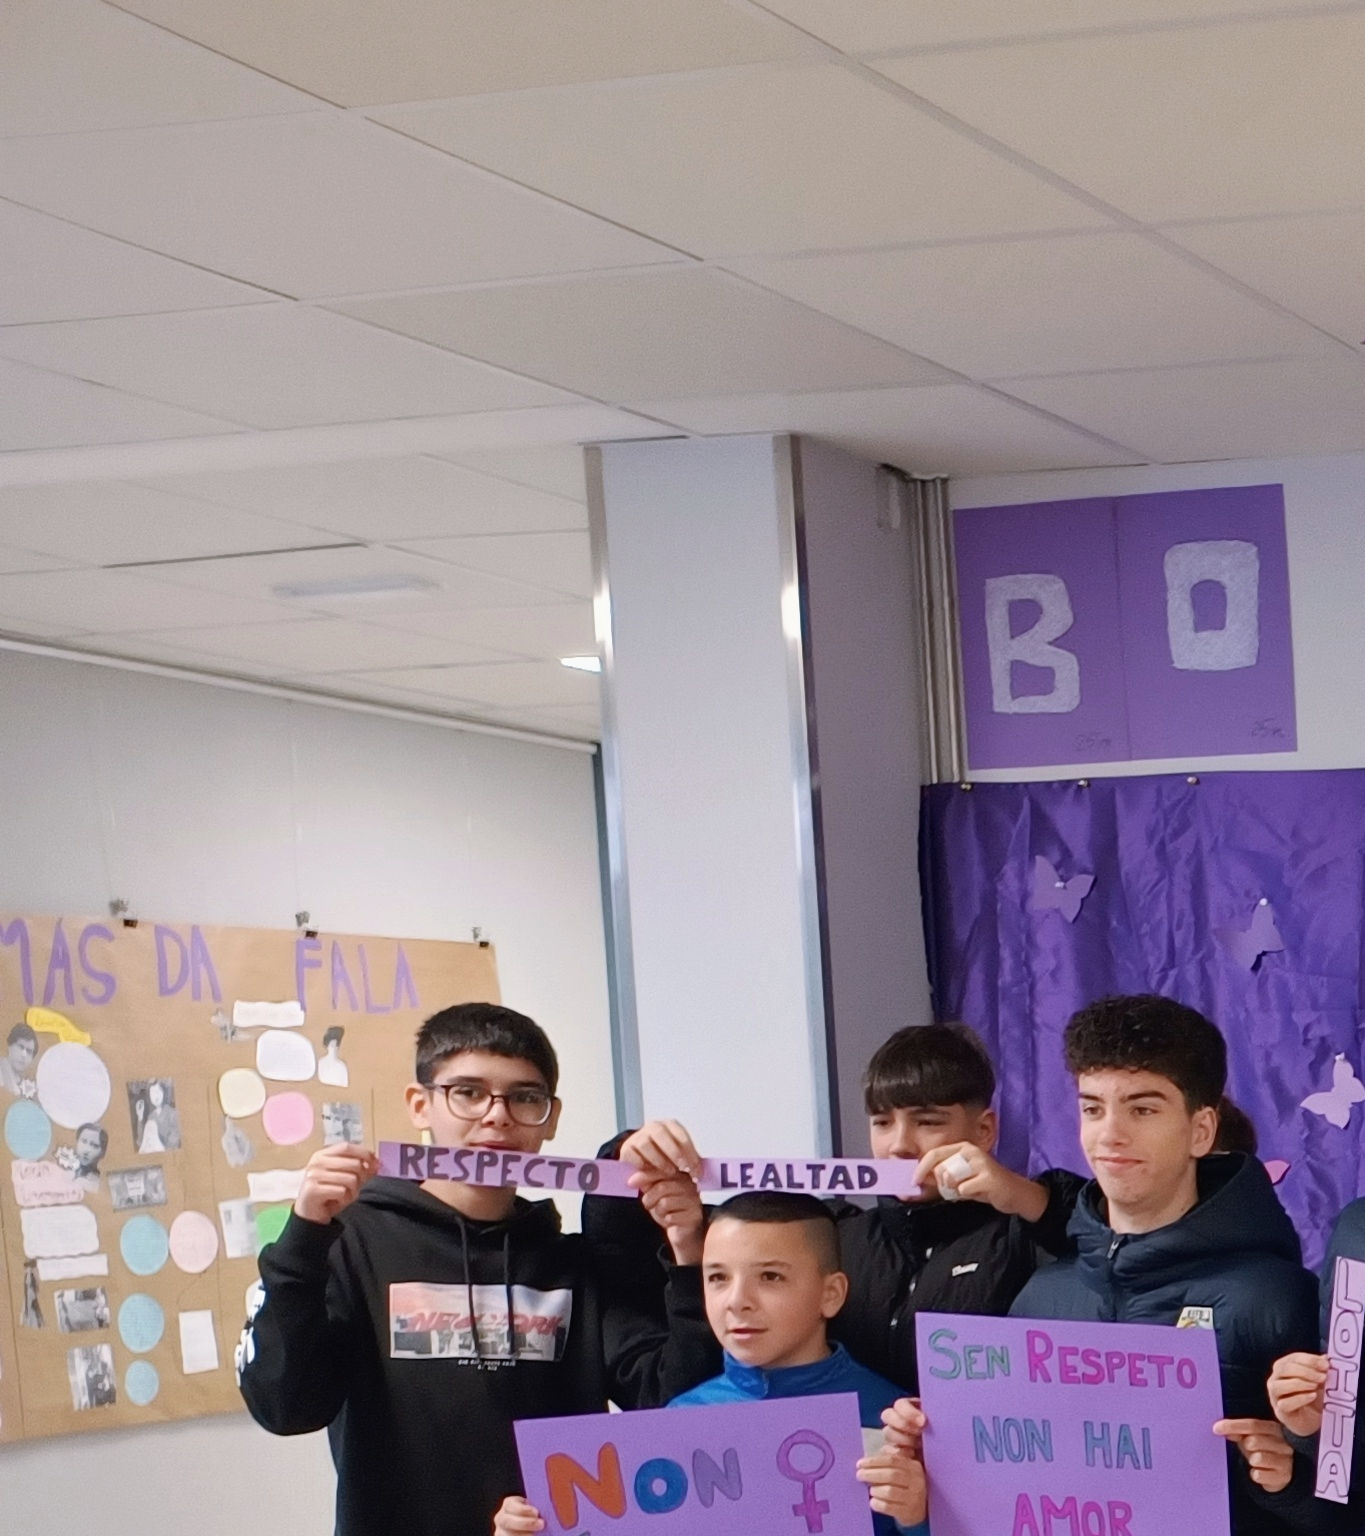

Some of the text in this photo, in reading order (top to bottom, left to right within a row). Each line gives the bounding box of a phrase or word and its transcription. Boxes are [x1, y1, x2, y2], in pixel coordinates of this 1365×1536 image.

[154, 924, 224, 1004] DA
[295, 938, 421, 1014] FALA
[399, 1143, 601, 1192] RESPECTO
[719, 1162, 879, 1190] LEALTAD
[1315, 1256, 1364, 1498] LOITA
[971, 1415, 1153, 1470] NON HAI
[545, 1441, 742, 1529] NON
